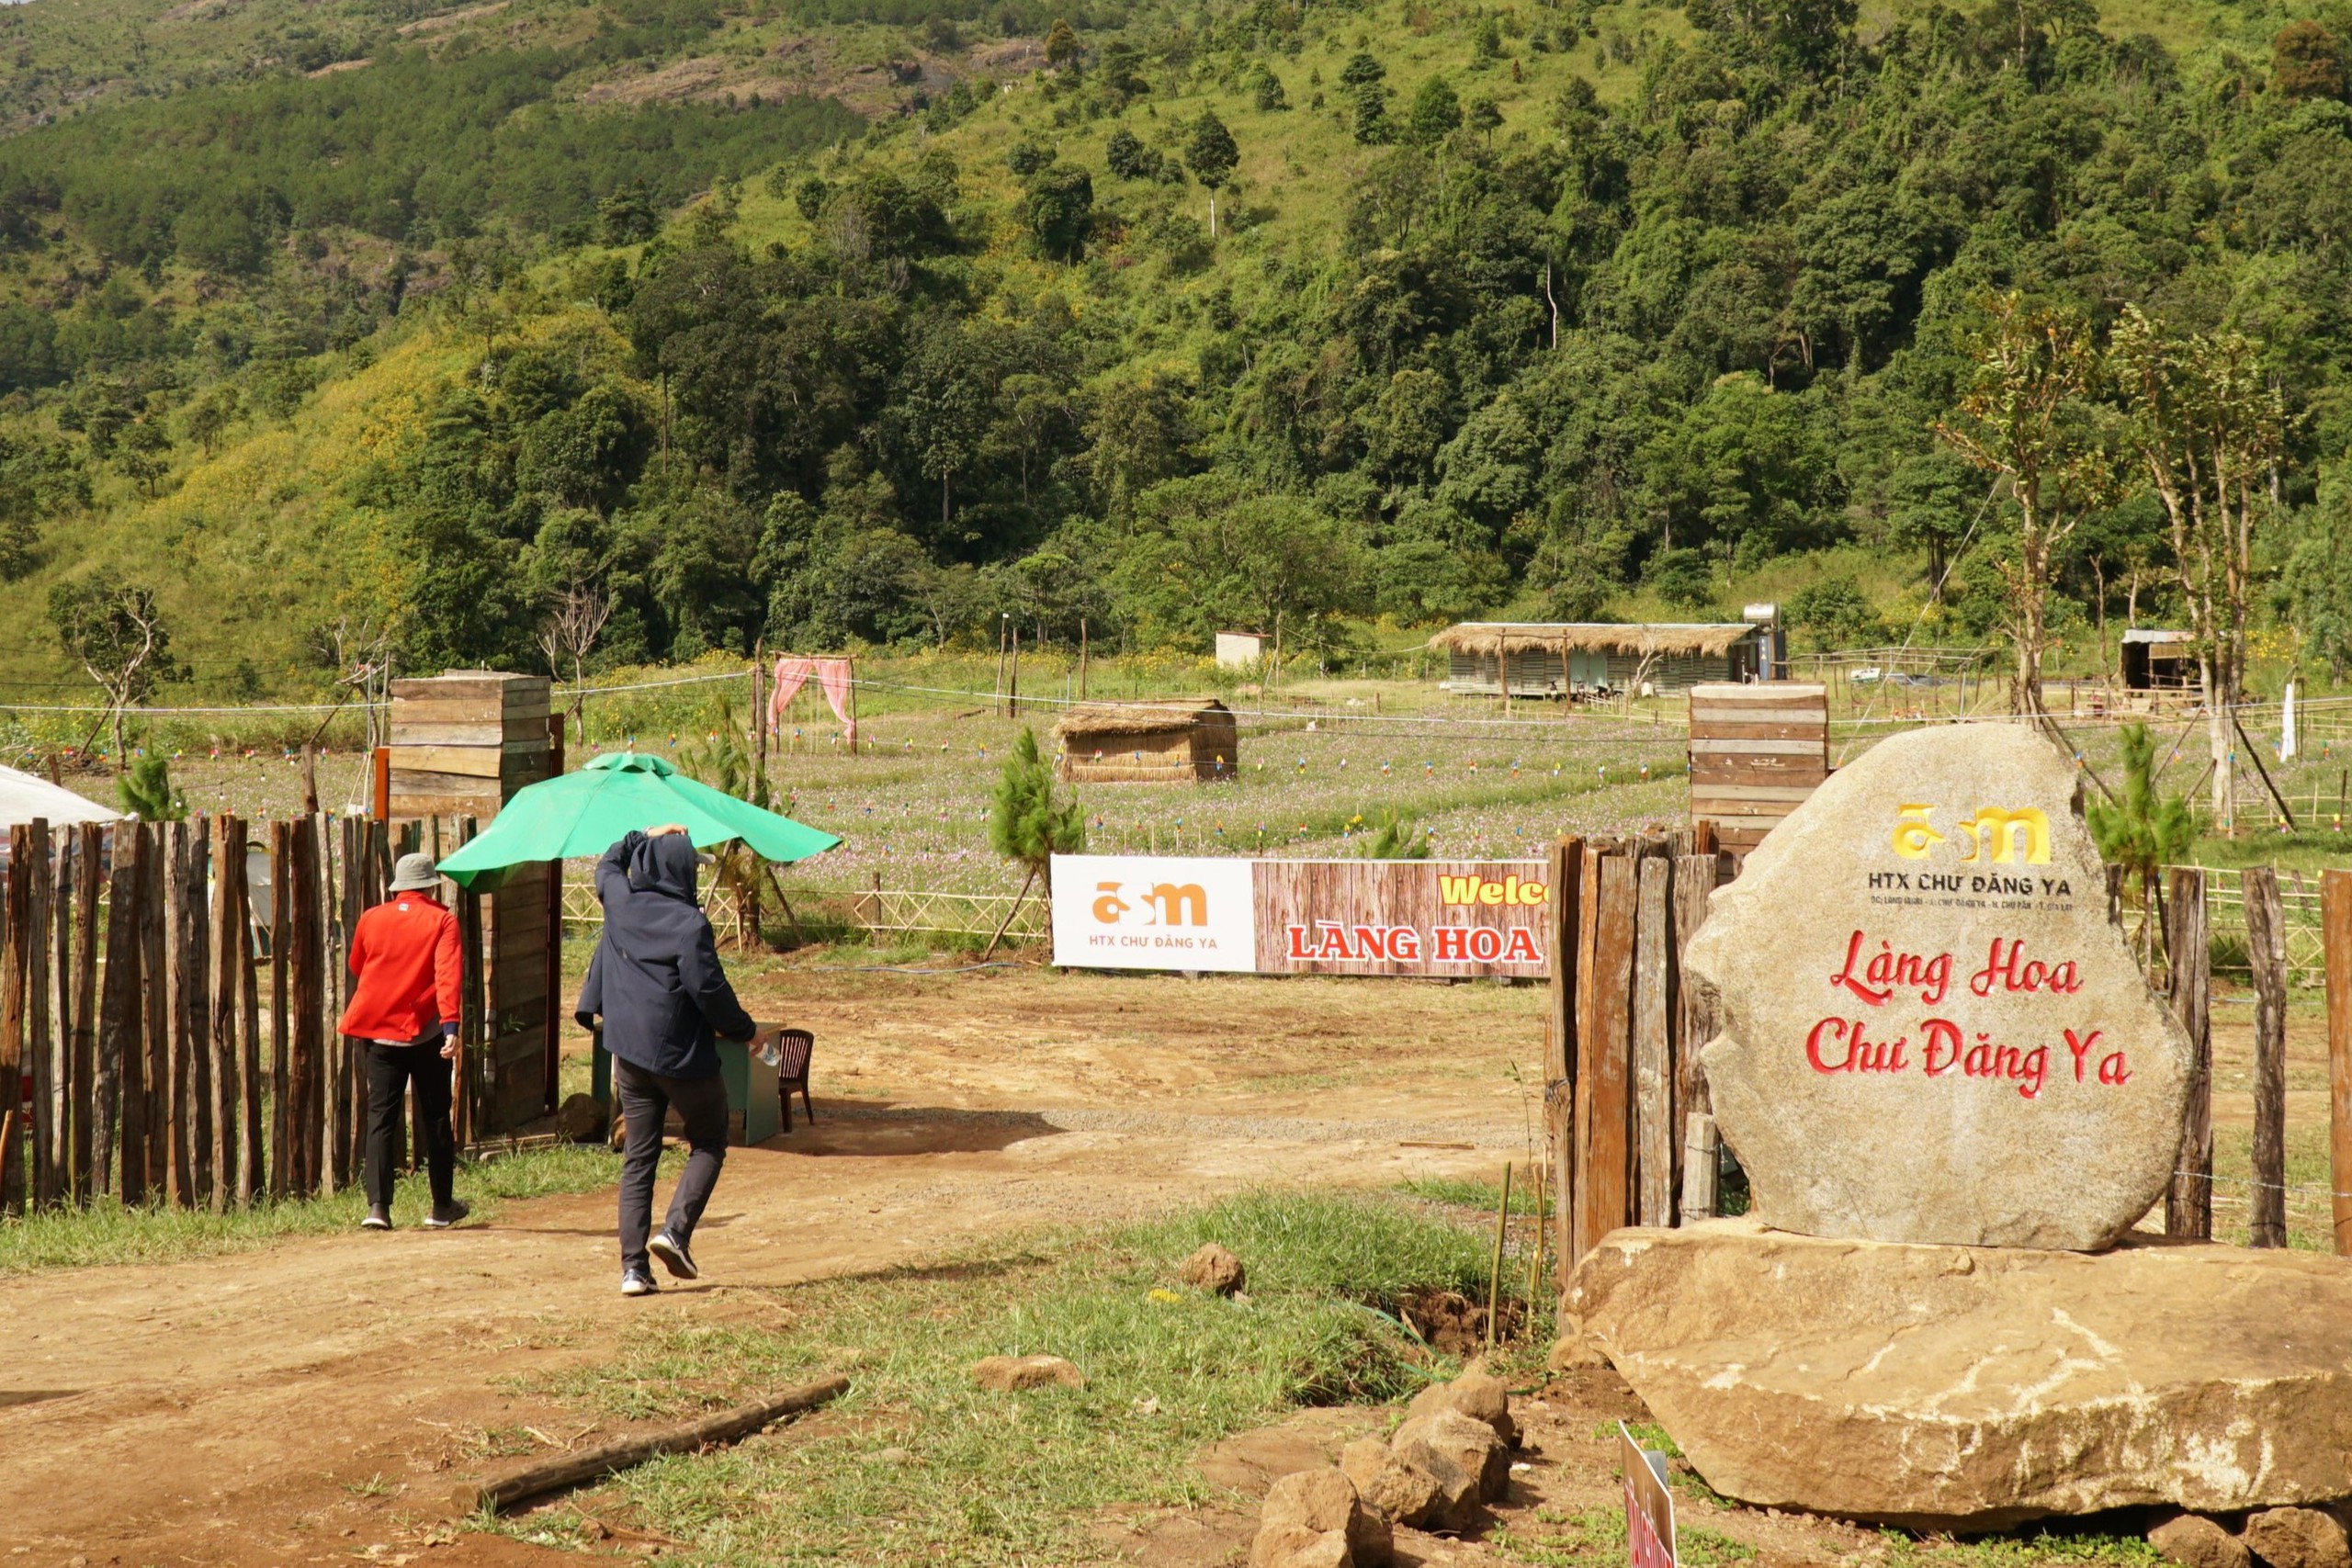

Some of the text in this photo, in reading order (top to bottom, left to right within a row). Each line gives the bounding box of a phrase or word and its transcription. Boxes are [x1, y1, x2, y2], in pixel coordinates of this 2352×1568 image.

[1439, 874, 1549, 907] Welc
[1869, 872, 2072, 897] HTX CHƯ ĐĂNG YA
[1089, 933, 1218, 950] HTX CHƯ ĐĂNG YA
[1287, 919, 1543, 963] LÀNG HOA
[1830, 930, 2085, 1006] Làng Hoa
[1805, 1016, 2133, 1099] Chư Đăng Ya
